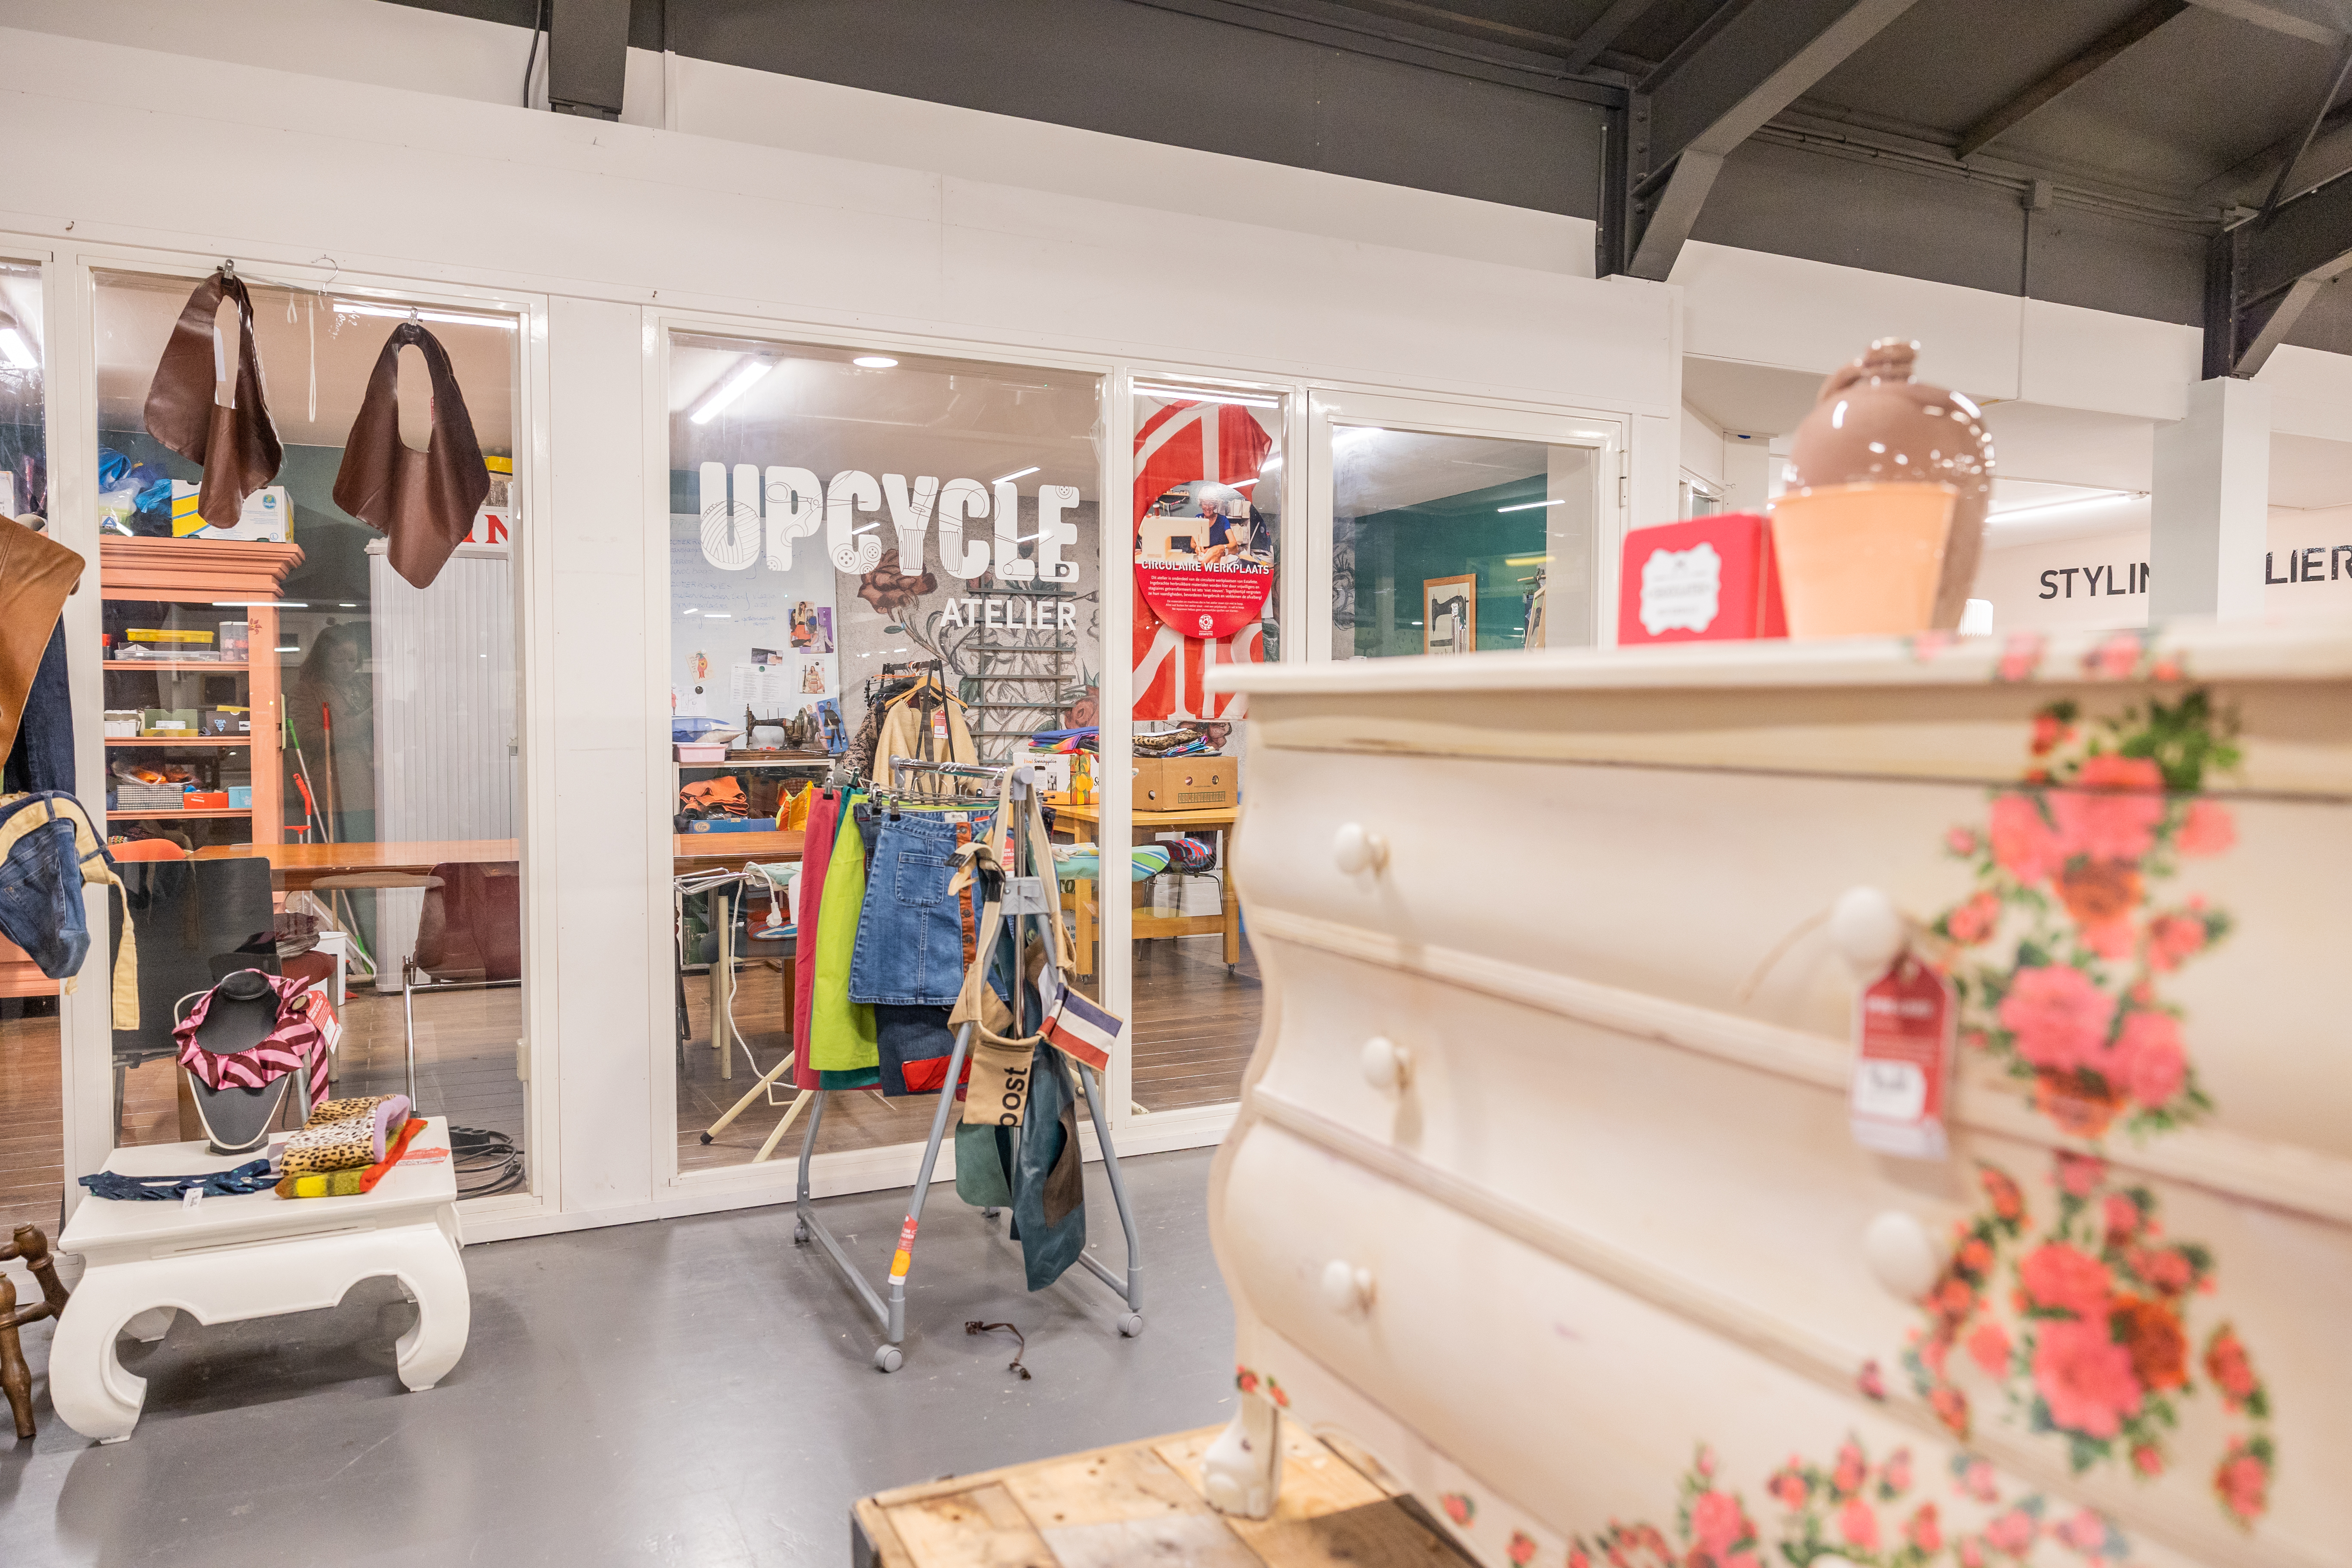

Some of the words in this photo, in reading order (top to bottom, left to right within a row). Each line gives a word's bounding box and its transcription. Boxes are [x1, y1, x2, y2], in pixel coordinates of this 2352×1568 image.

[699, 462, 1079, 583] UPCYCLE
[1141, 560, 1201, 572] CIRCULAIRE
[1204, 563, 1269, 575] WERKPLAATS
[939, 598, 1076, 631] ATELIER
